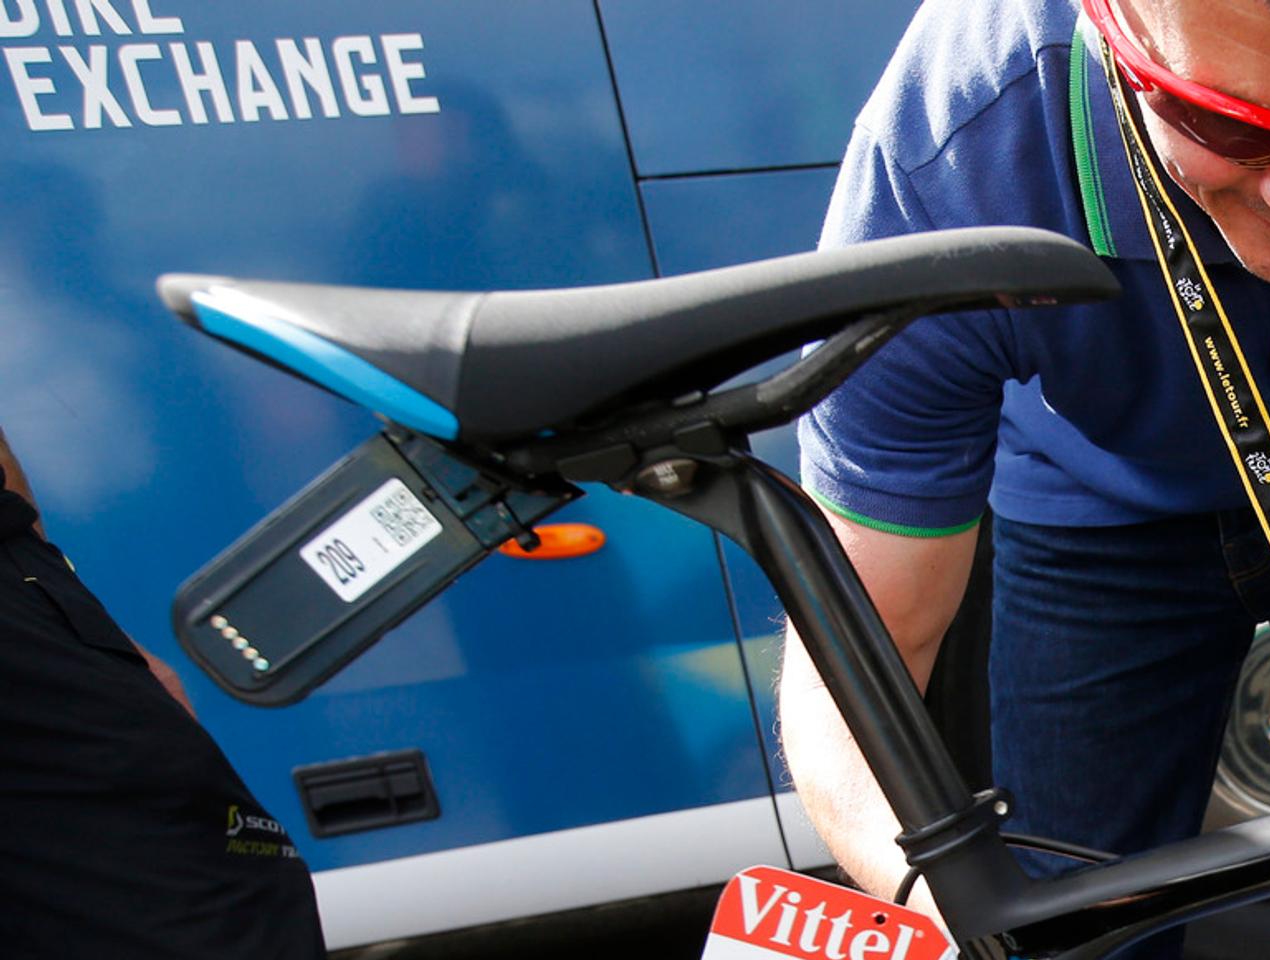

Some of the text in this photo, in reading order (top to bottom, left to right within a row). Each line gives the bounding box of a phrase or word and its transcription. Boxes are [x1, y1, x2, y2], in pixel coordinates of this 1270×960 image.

[4, 34, 440, 130] EXCHANGE
[1204, 336, 1249, 429] www.letour.fr
[316, 538, 365, 584] 209
